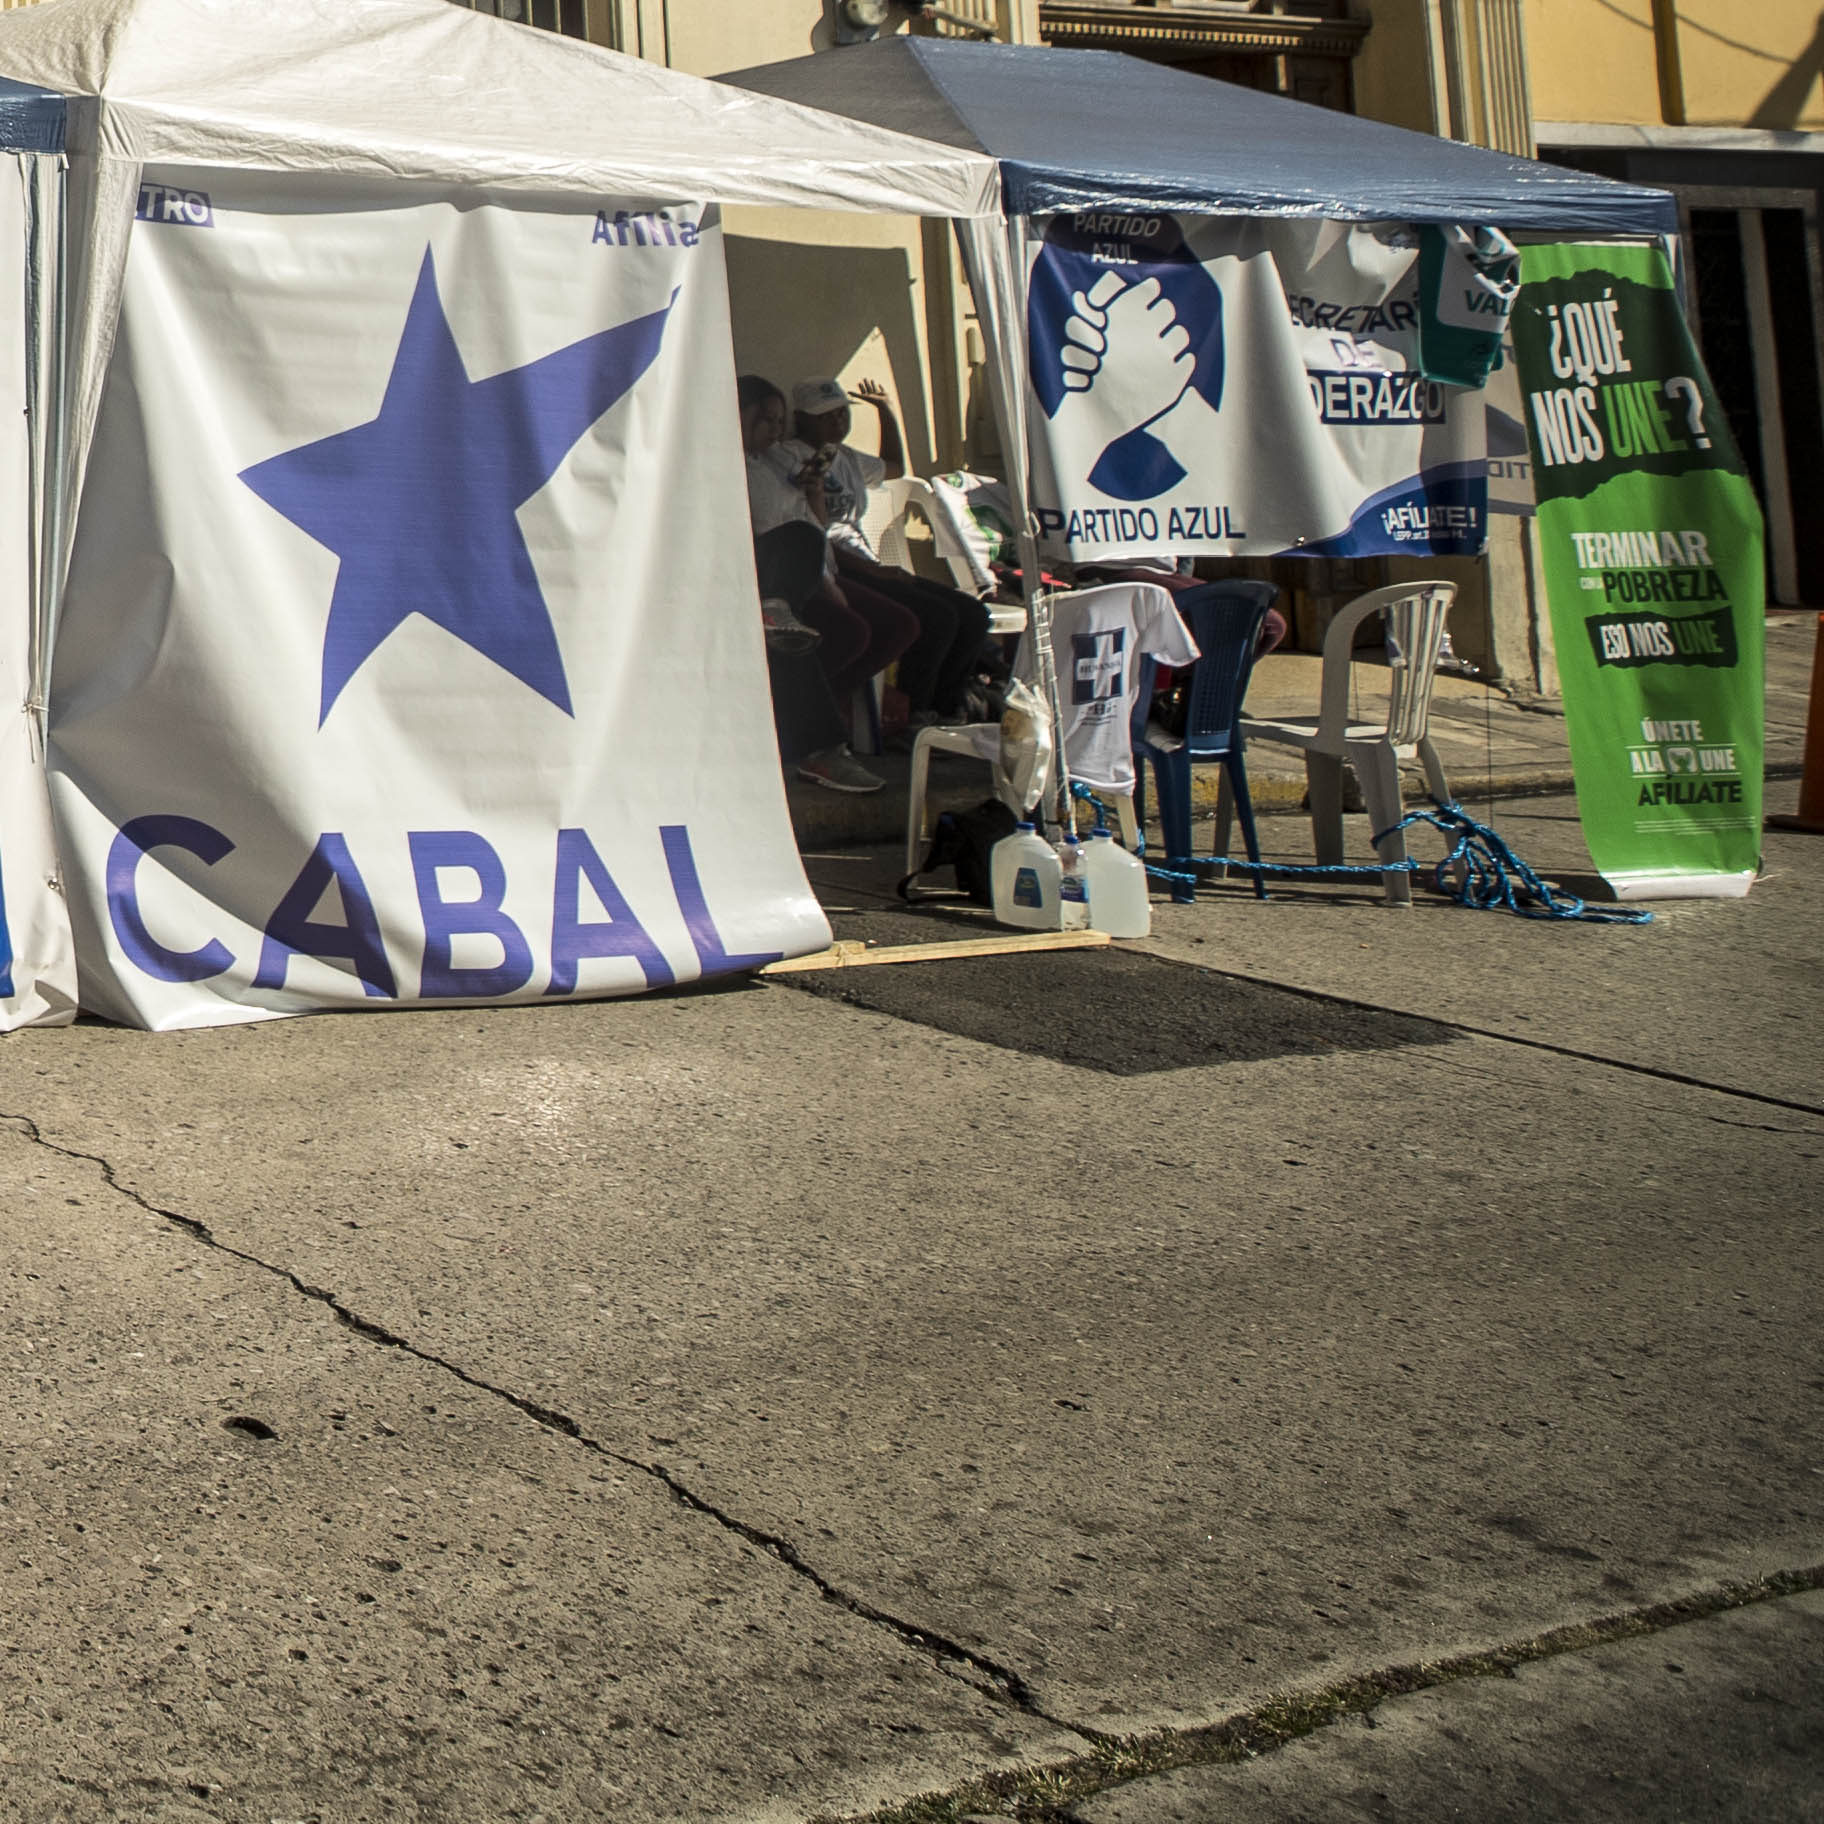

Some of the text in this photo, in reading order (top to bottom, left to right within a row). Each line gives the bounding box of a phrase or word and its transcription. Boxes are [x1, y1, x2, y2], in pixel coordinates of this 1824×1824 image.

[1074, 213, 1161, 237] PARTIDO
[1091, 242, 1138, 264] AZUL
[1548, 288, 1632, 387] ¿QUÉ
[1531, 377, 1712, 466] NOS UNE?
[1038, 506, 1247, 543] PARTIDO AZUL
[1571, 531, 1713, 569] TERMINAR
[1602, 569, 1729, 603] POBREZA
[1600, 620, 1724, 659] ESO NOS UNE
[1640, 717, 1704, 742] ÚNETE
[1698, 749, 1737, 771] UNE
[106, 814, 785, 999] CABAL
